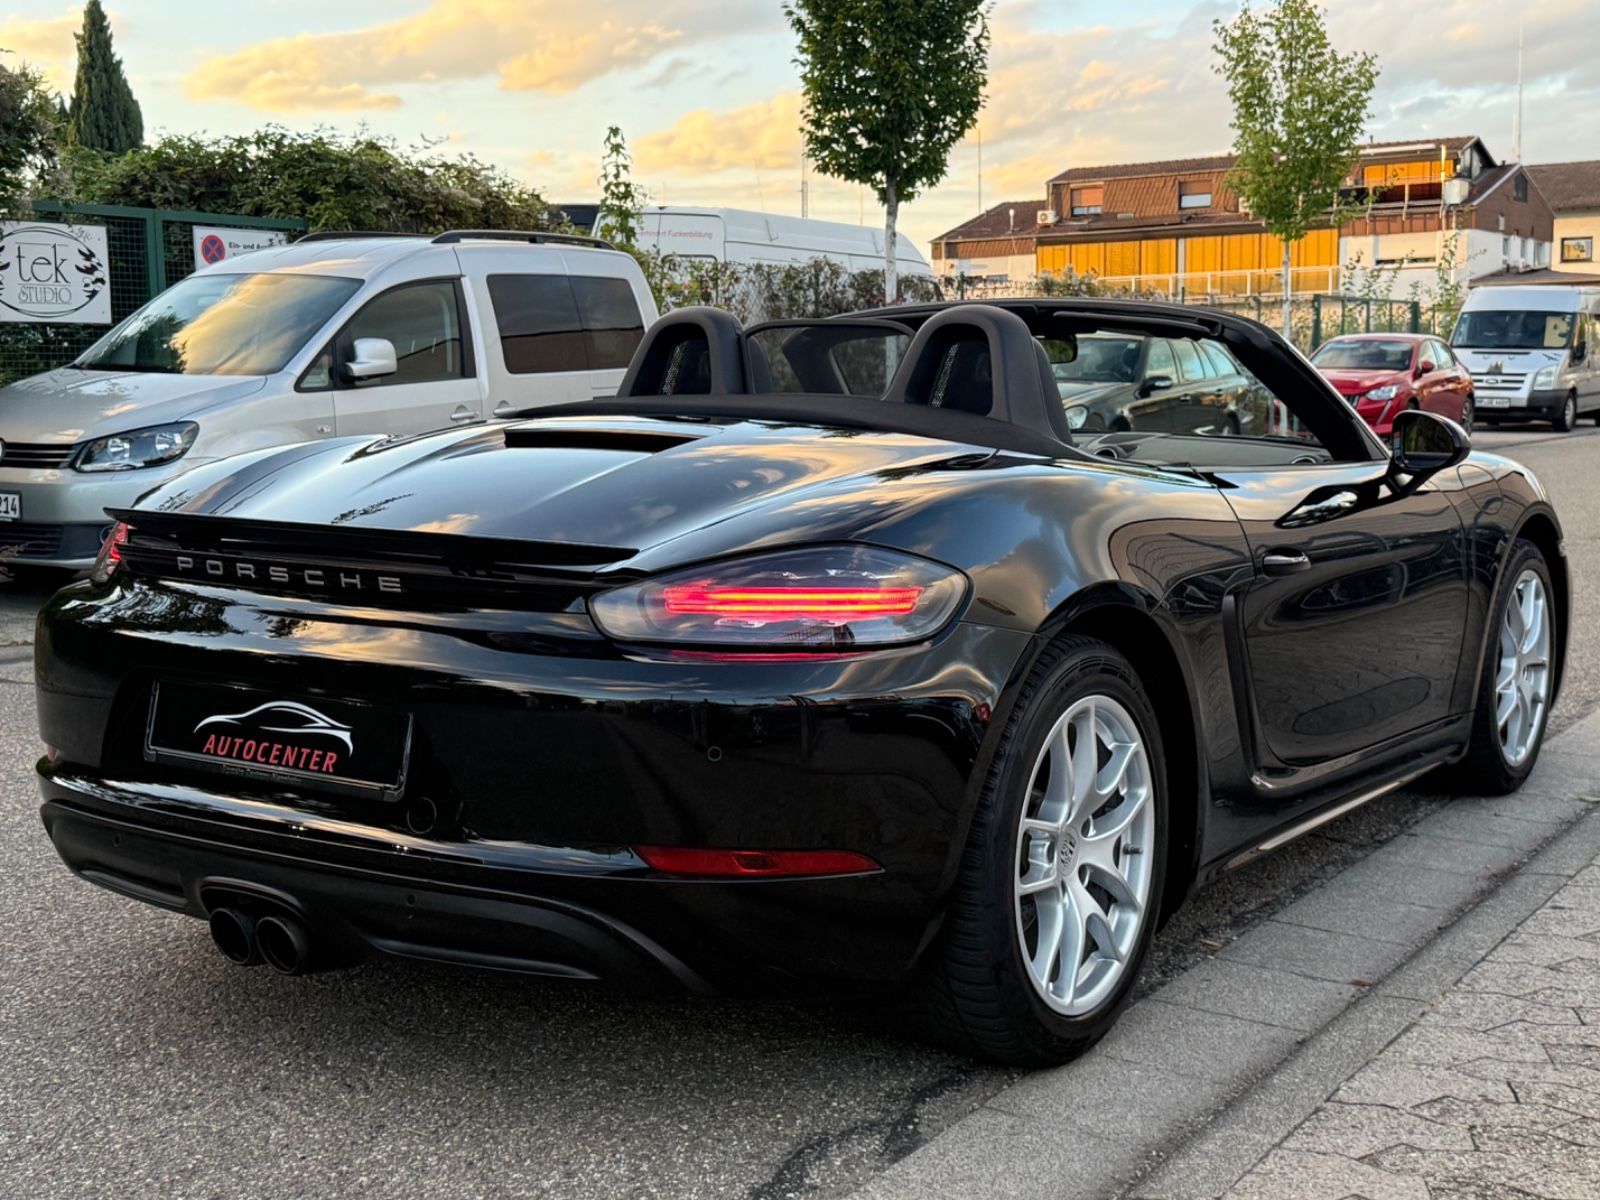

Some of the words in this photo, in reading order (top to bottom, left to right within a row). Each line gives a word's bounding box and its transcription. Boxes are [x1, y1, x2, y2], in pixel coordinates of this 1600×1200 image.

[16, 243, 70, 284] tek
[18, 286, 72, 303] STUDIO
[176, 556, 402, 593] PORSCHE
[202, 733, 338, 773] AUTOCENTER
